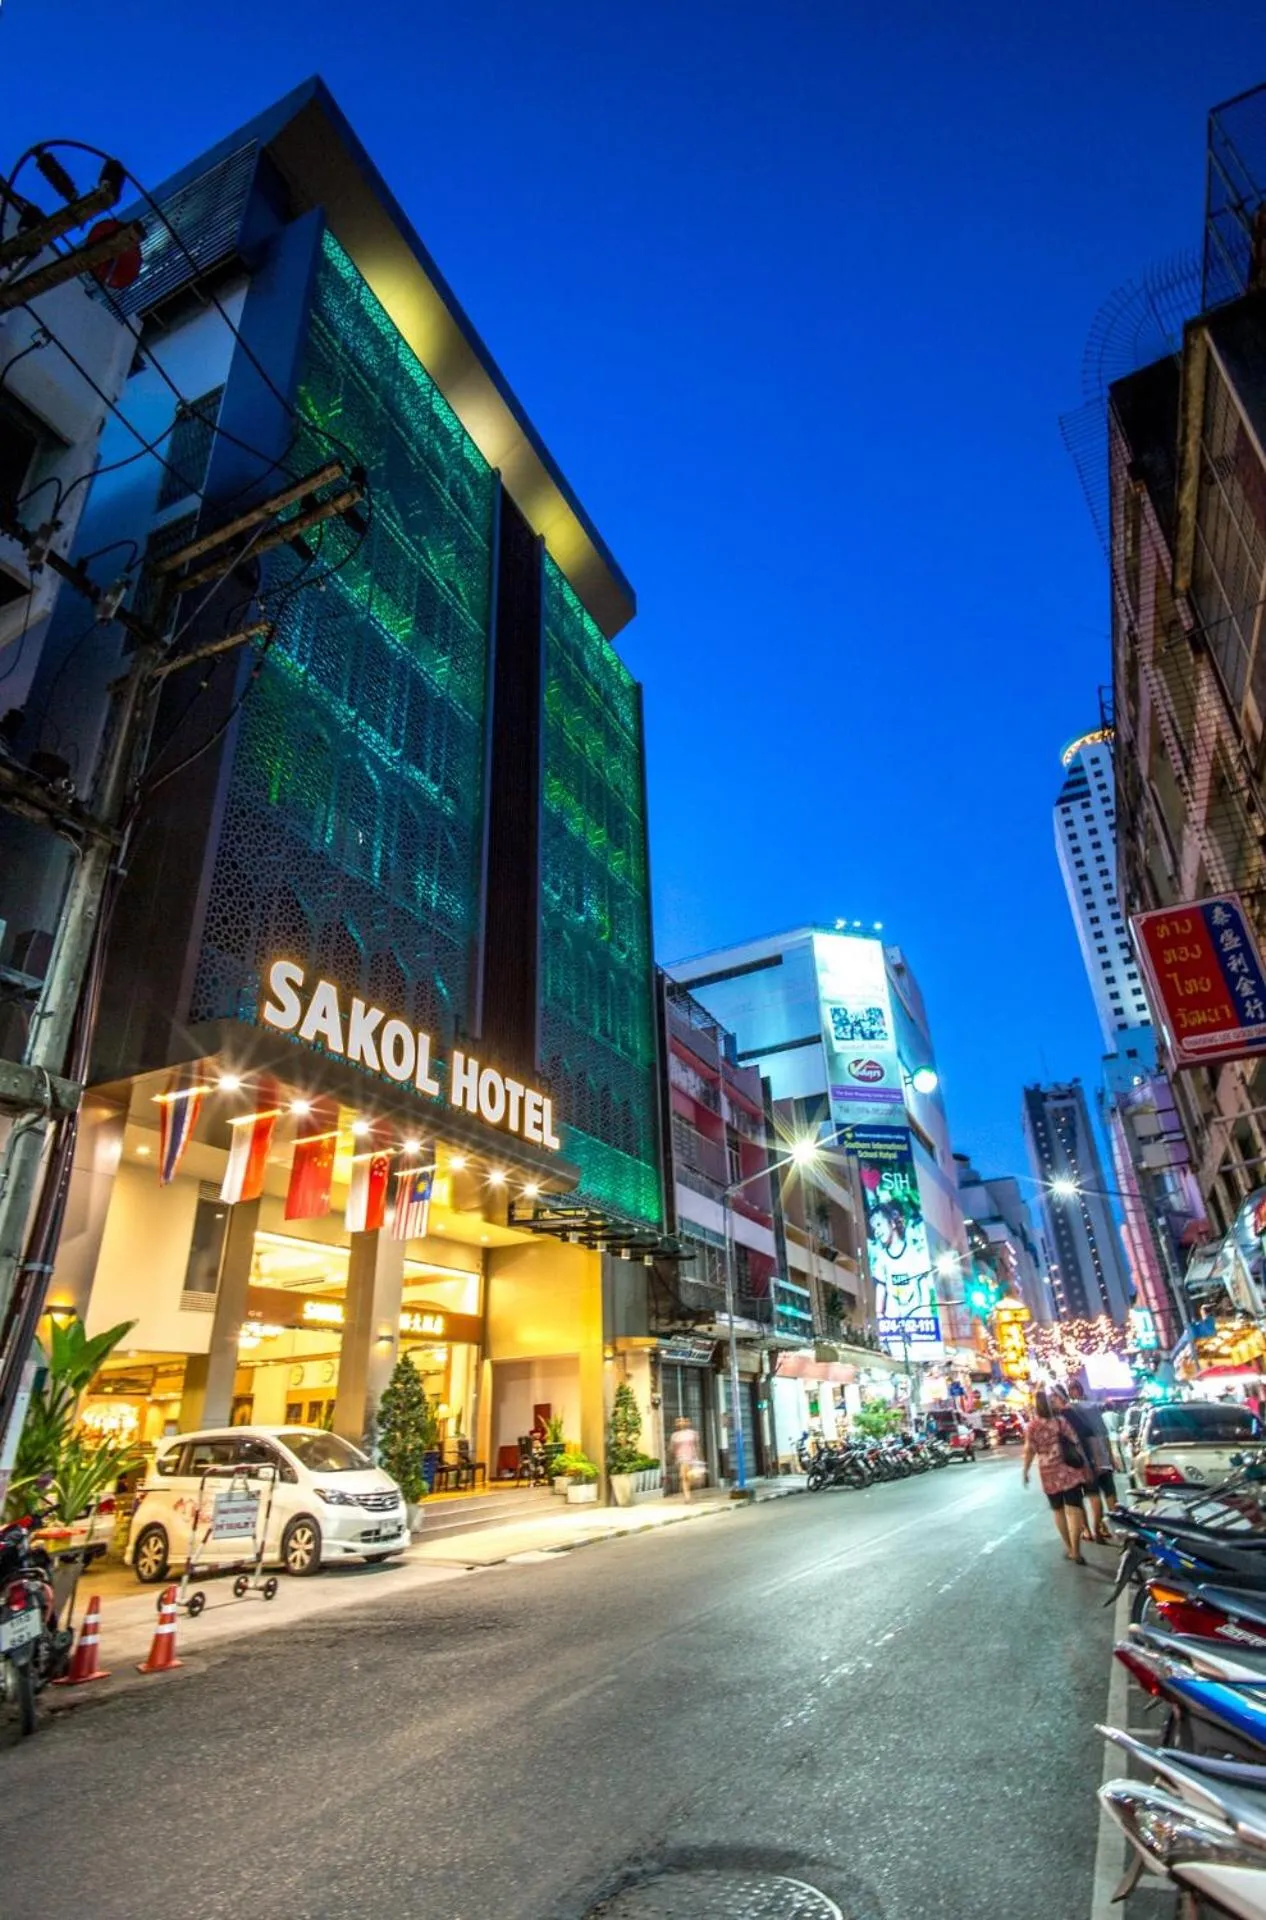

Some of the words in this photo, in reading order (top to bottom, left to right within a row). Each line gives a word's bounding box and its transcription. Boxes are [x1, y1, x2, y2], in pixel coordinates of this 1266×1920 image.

[1166, 972, 1212, 996] ไทย
[264, 960, 440, 1097] SAKOL
[451, 1050, 560, 1151] HOTEL
